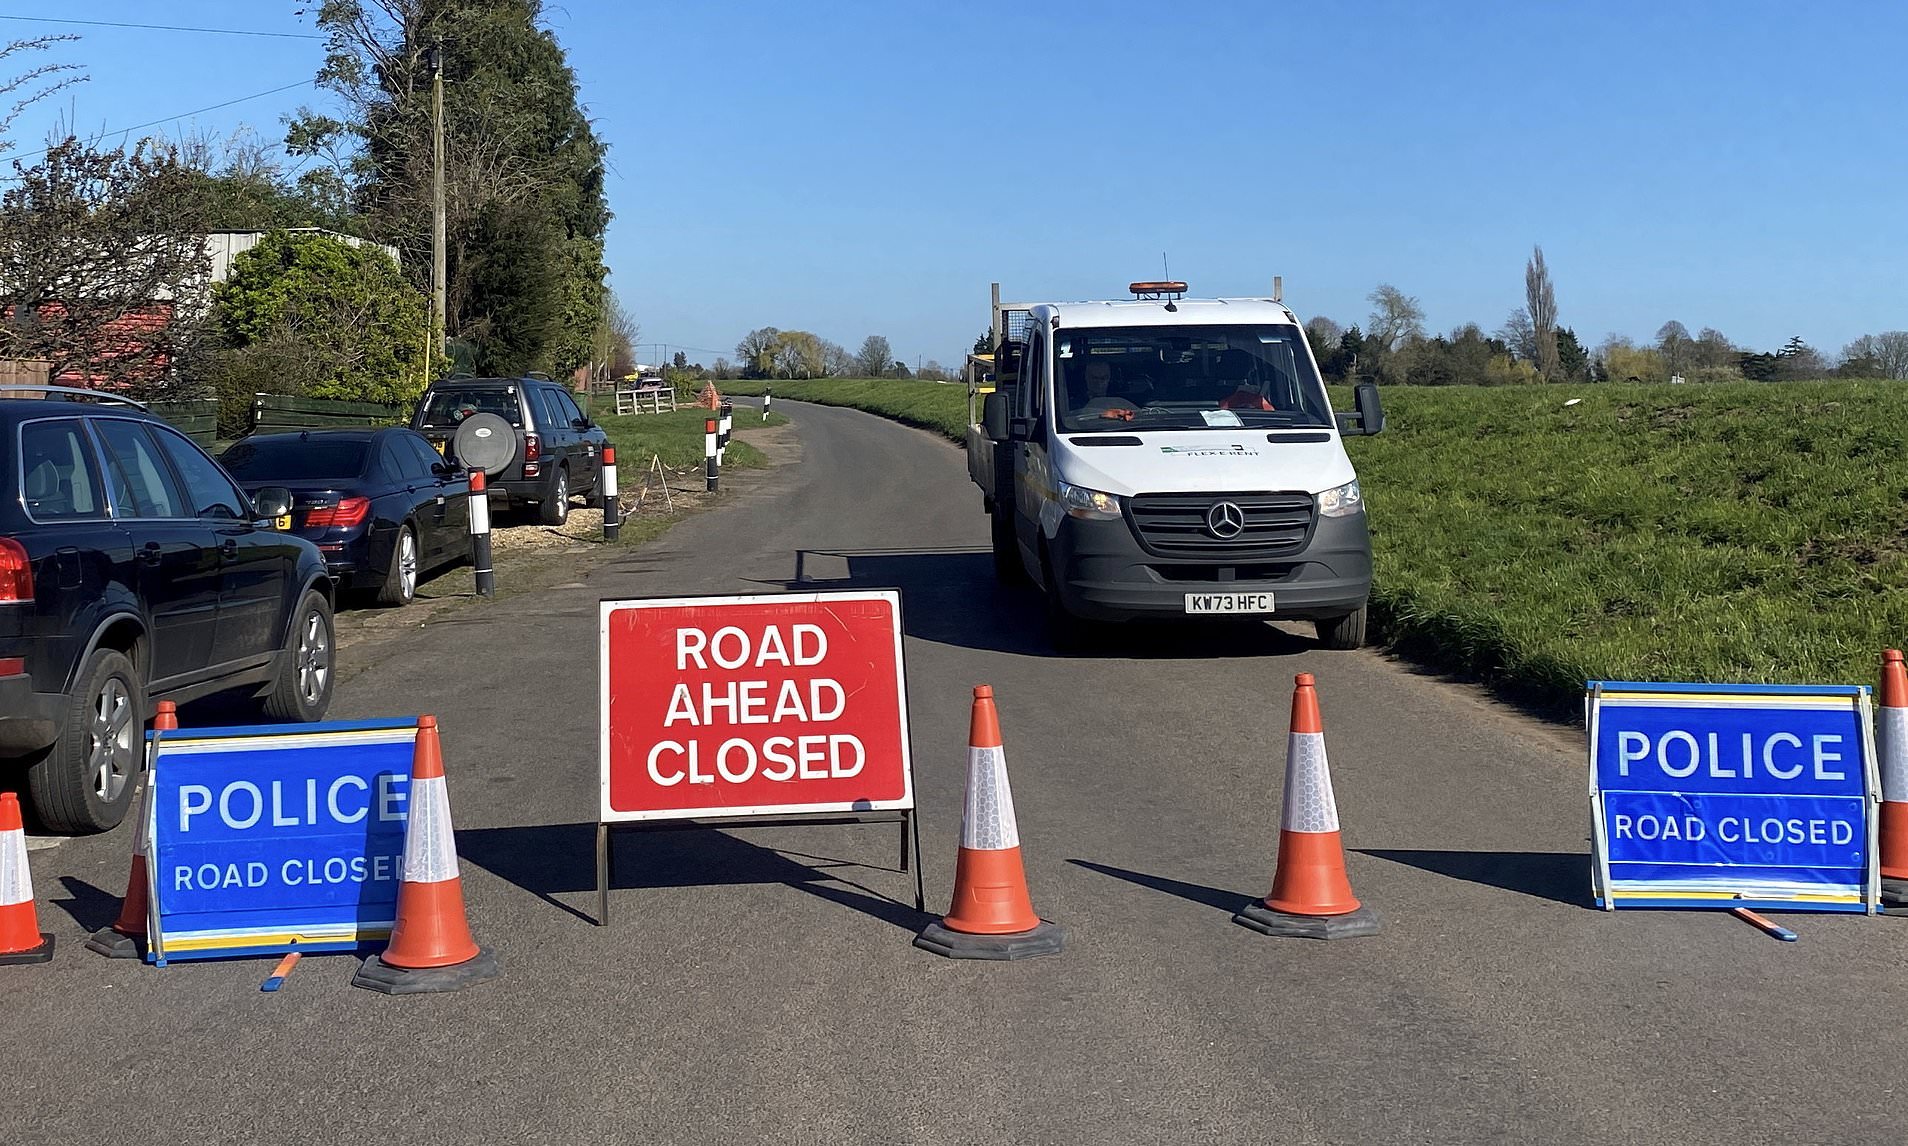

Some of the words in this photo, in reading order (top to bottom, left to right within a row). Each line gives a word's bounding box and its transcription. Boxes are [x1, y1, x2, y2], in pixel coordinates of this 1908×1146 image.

[1192, 595, 1233, 611] KW73
[1237, 595, 1267, 610] HFC
[676, 623, 828, 671] ROAD
[663, 677, 847, 728] AHEAD
[646, 733, 867, 787] CLOSED
[1617, 729, 1846, 781] POLICE
[178, 773, 409, 833] POLICE
[1614, 814, 1706, 842] ROAD
[1717, 816, 1854, 846] CLOSED
[174, 861, 269, 891] ROAD
